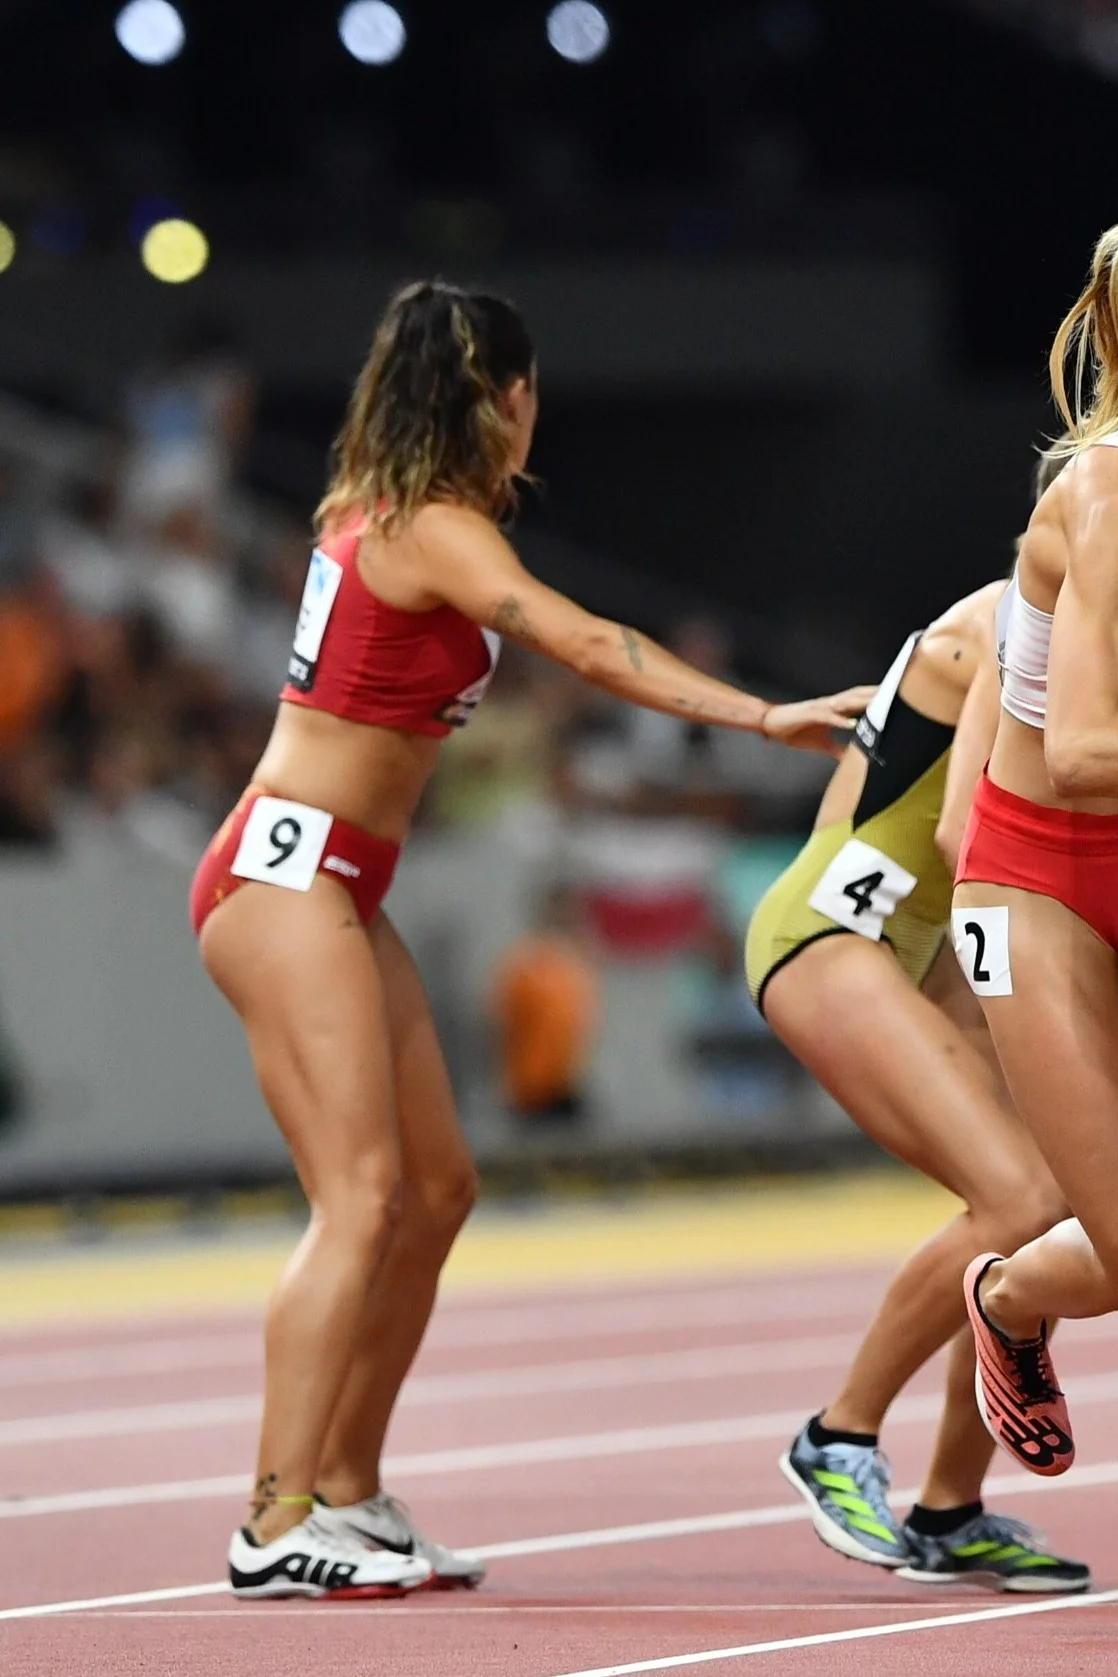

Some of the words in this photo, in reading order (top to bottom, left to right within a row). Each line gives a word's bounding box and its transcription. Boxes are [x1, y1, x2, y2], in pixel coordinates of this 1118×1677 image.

[265, 817, 302, 869] 9
[843, 871, 884, 916] 4
[965, 922, 990, 982] 2
